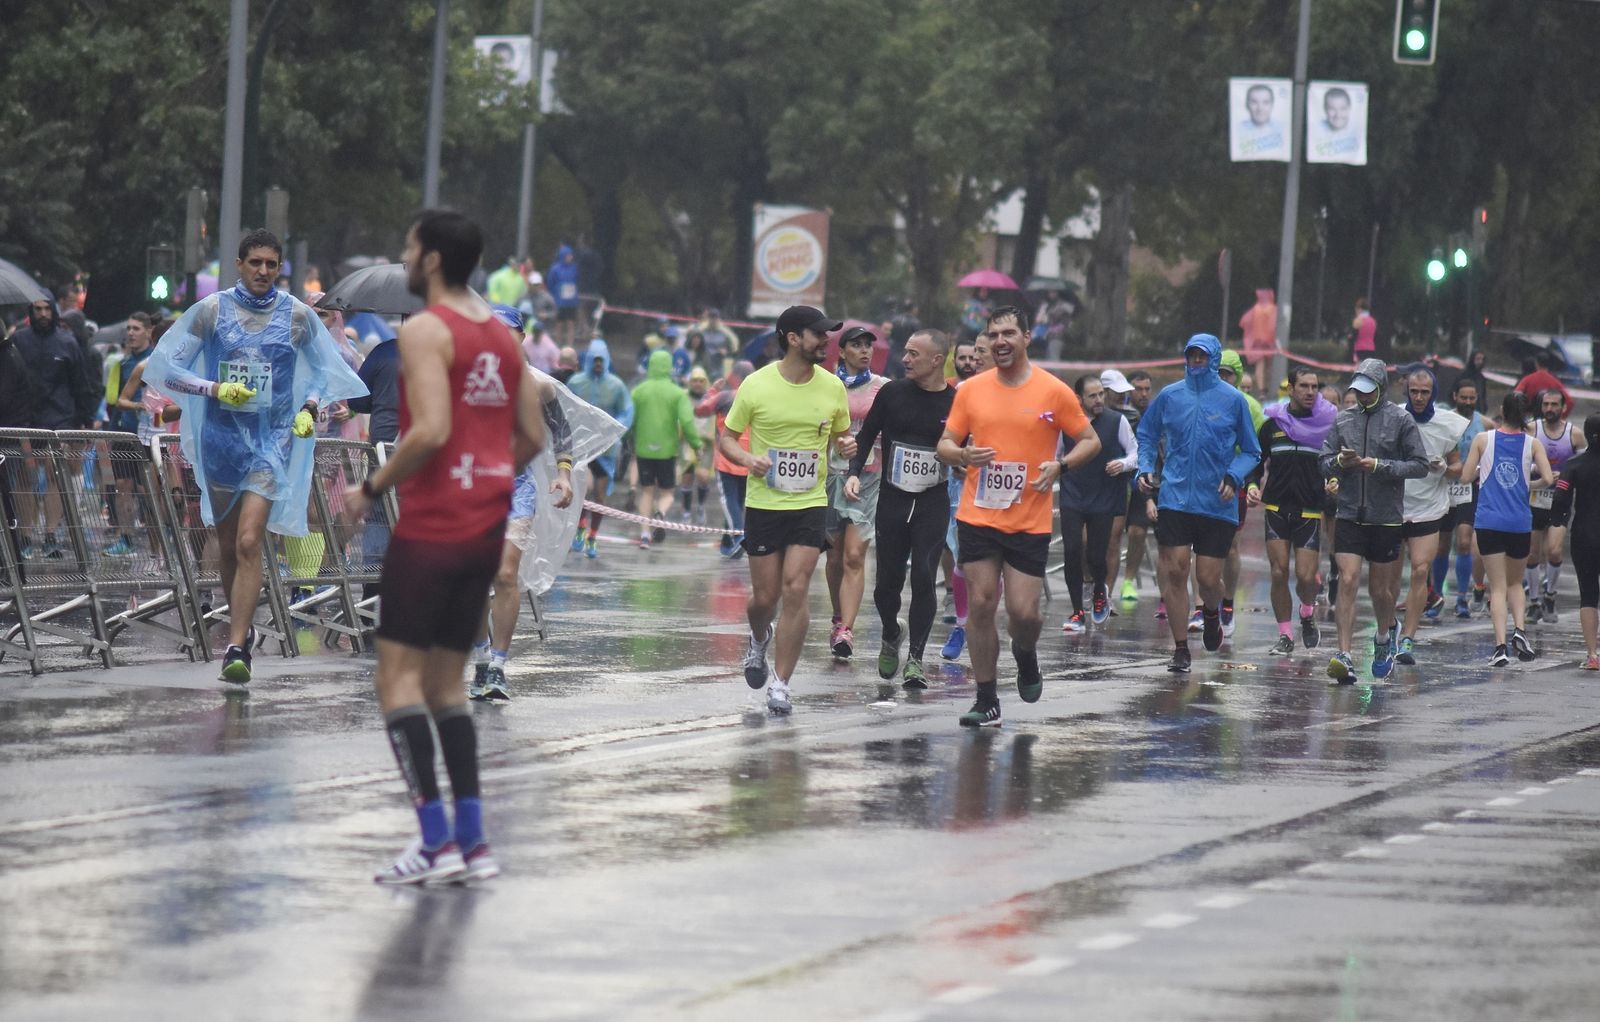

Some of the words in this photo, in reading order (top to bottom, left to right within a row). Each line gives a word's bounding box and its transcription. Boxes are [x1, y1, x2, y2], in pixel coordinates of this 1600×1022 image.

[778, 461, 816, 478] 6904
[903, 460, 937, 476] 6684
[987, 473, 1023, 490] 6902
[1449, 486, 1470, 496] 1225
